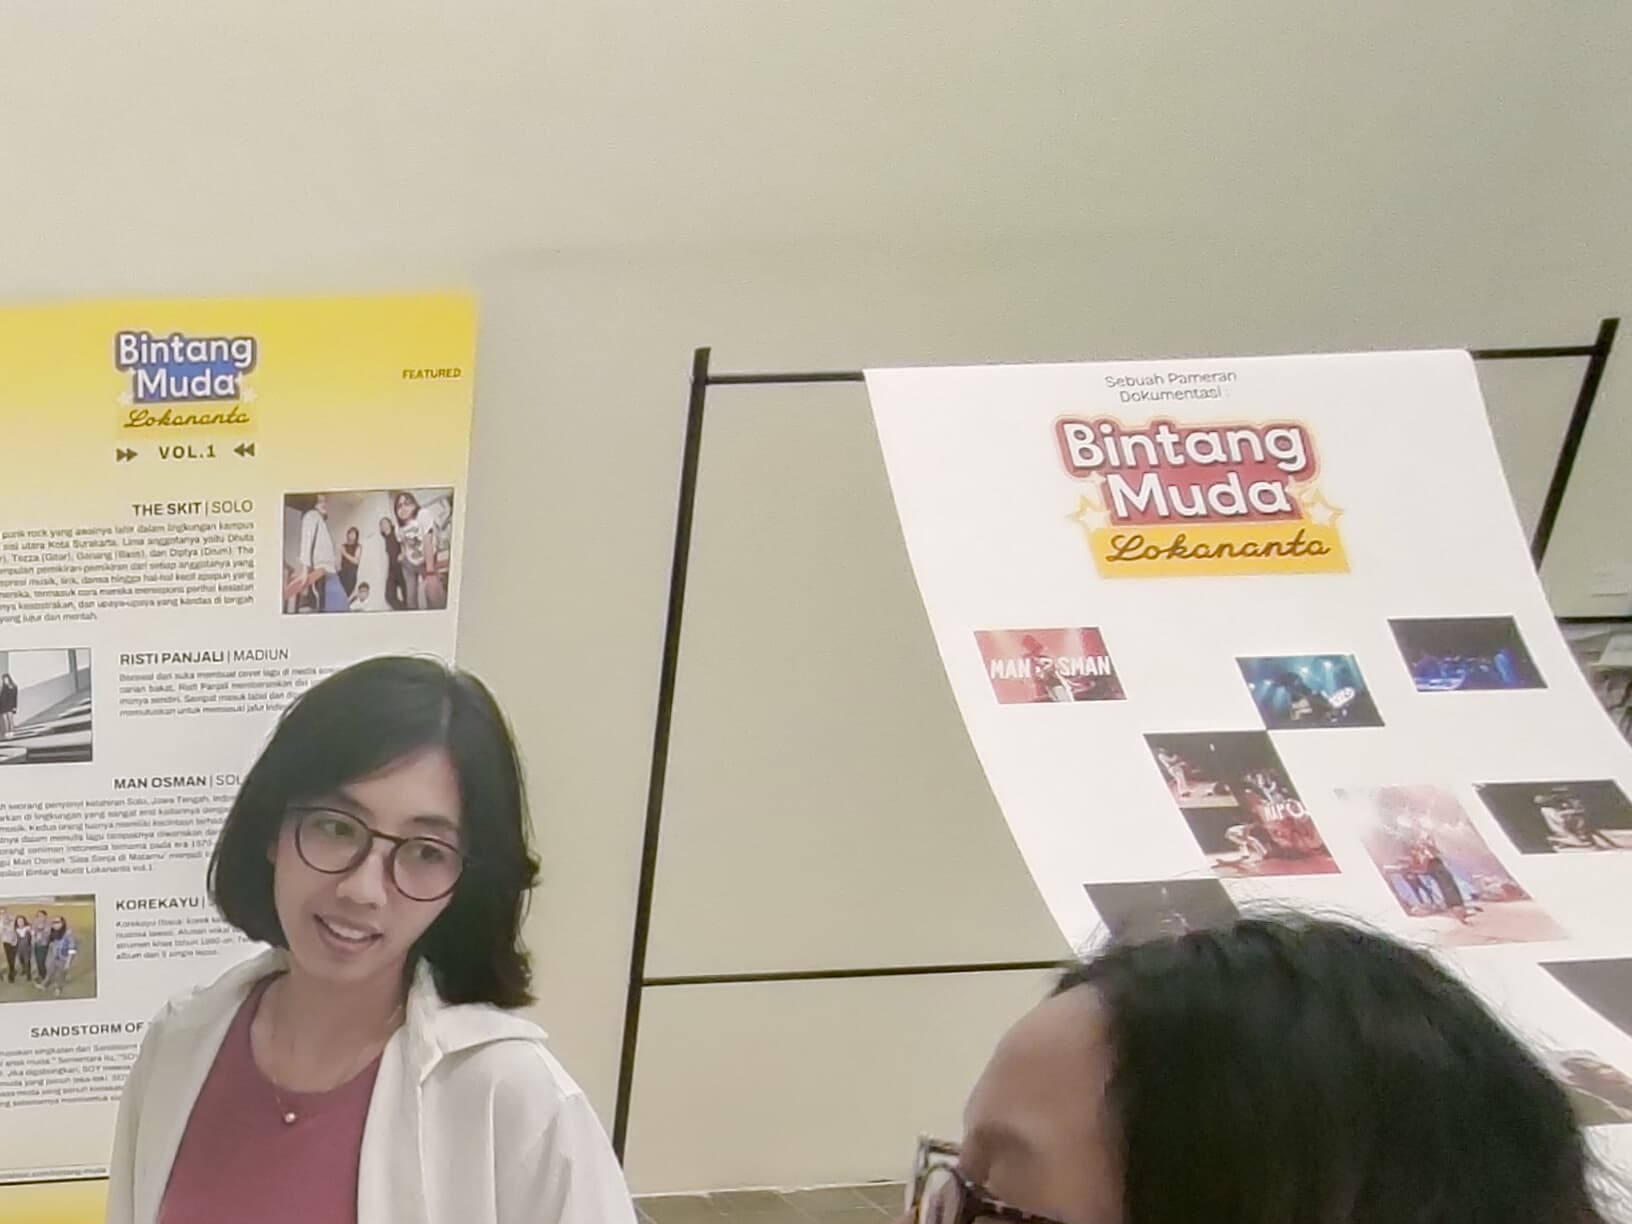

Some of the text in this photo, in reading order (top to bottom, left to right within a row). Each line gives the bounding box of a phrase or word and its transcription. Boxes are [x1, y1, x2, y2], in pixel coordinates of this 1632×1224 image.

[119, 333, 252, 368] Bintang
[402, 367, 462, 380] FEATURED
[1104, 370, 1237, 388] Sebuah Pameran
[137, 367, 236, 399] Muda
[1119, 386, 1221, 402] Dokumentasi
[123, 405, 250, 428] Lokananta
[159, 444, 217, 460] VOL.1
[1062, 422, 1308, 472] Bintang
[1105, 471, 1292, 518] Muda
[132, 499, 253, 516] THE SKIT SOLO
[1105, 528, 1331, 562] Lokananta
[120, 648, 289, 665] RISTI PANJALI MADIUN
[990, 655, 1112, 680] MAN SMAN
[114, 774, 243, 790] MAN OSMAN SOL
[116, 896, 199, 911] KOREKAYU
[31, 1021, 144, 1038] SANDSTORM OF
